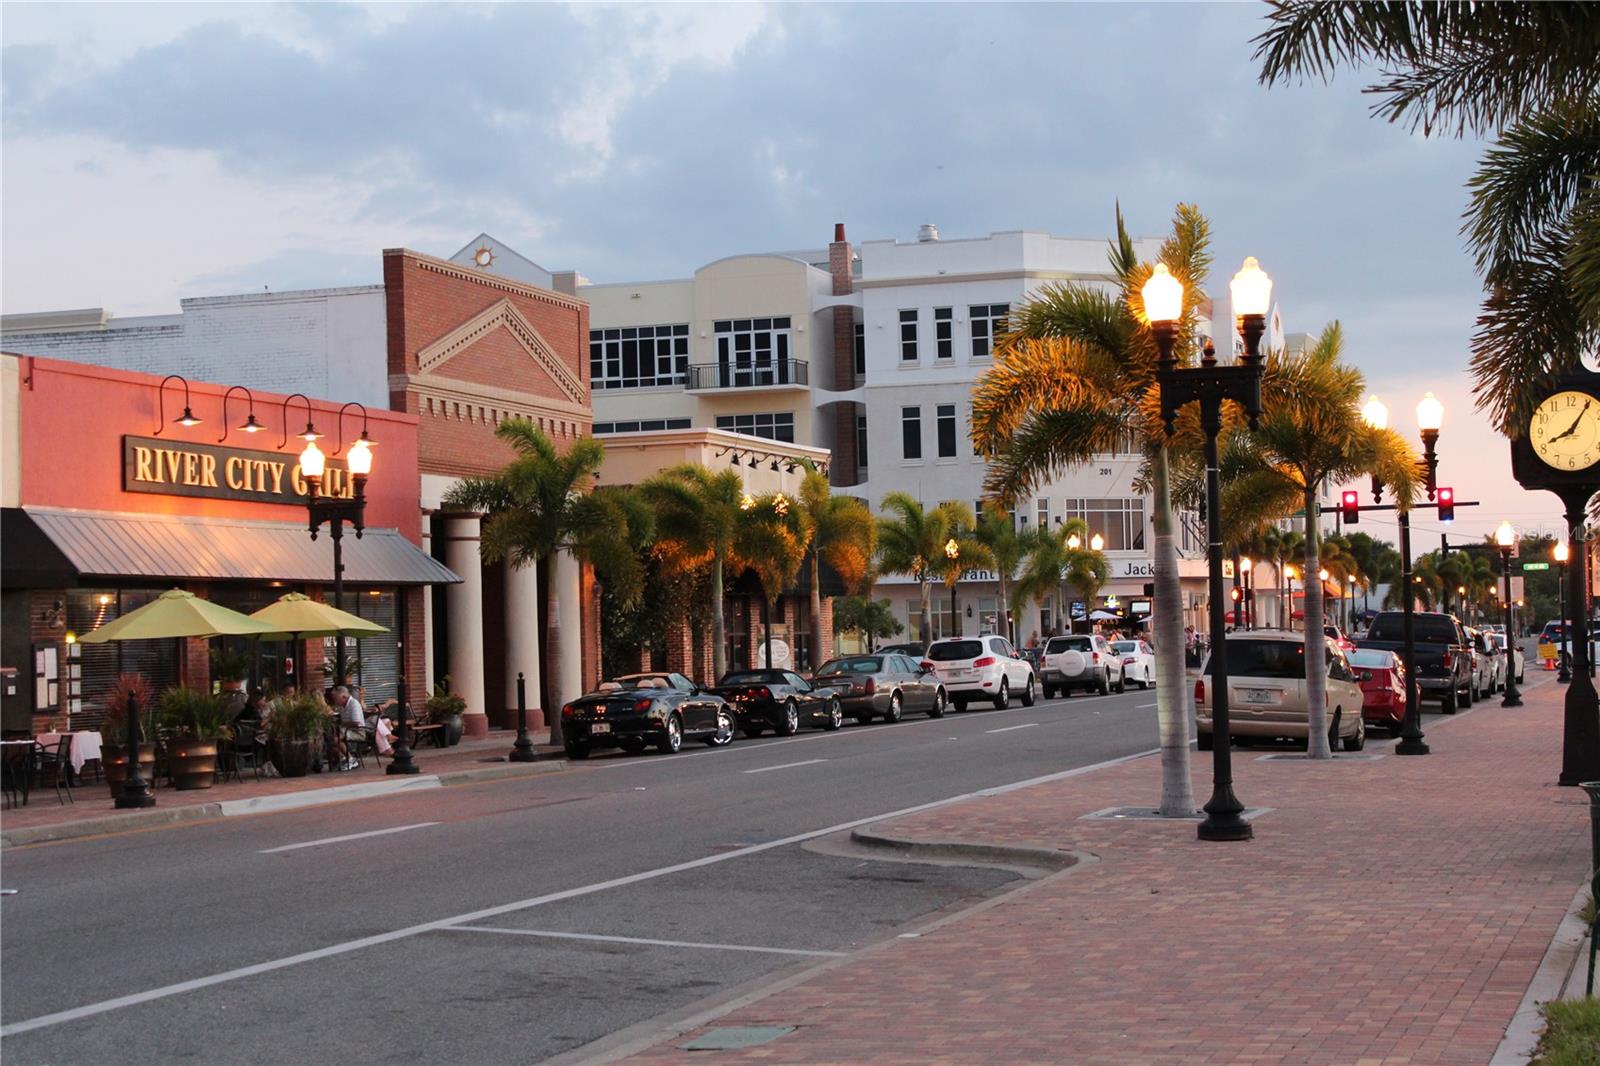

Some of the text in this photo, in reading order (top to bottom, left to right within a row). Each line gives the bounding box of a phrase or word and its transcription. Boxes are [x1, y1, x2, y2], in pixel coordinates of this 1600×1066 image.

[1550, 400, 1558, 412] 11
[1566, 396, 1577, 407] 12
[1538, 413, 1549, 424] 10
[1537, 427, 1544, 436] 9
[1540, 443, 1547, 455] 8
[1553, 454, 1561, 466] 7
[1568, 456, 1576, 468] 6
[1584, 453, 1592, 465] 5
[134, 446, 354, 500] RIVER CITY GILL
[1099, 468, 1112, 476] 201
[913, 567, 996, 582] Rstrant
